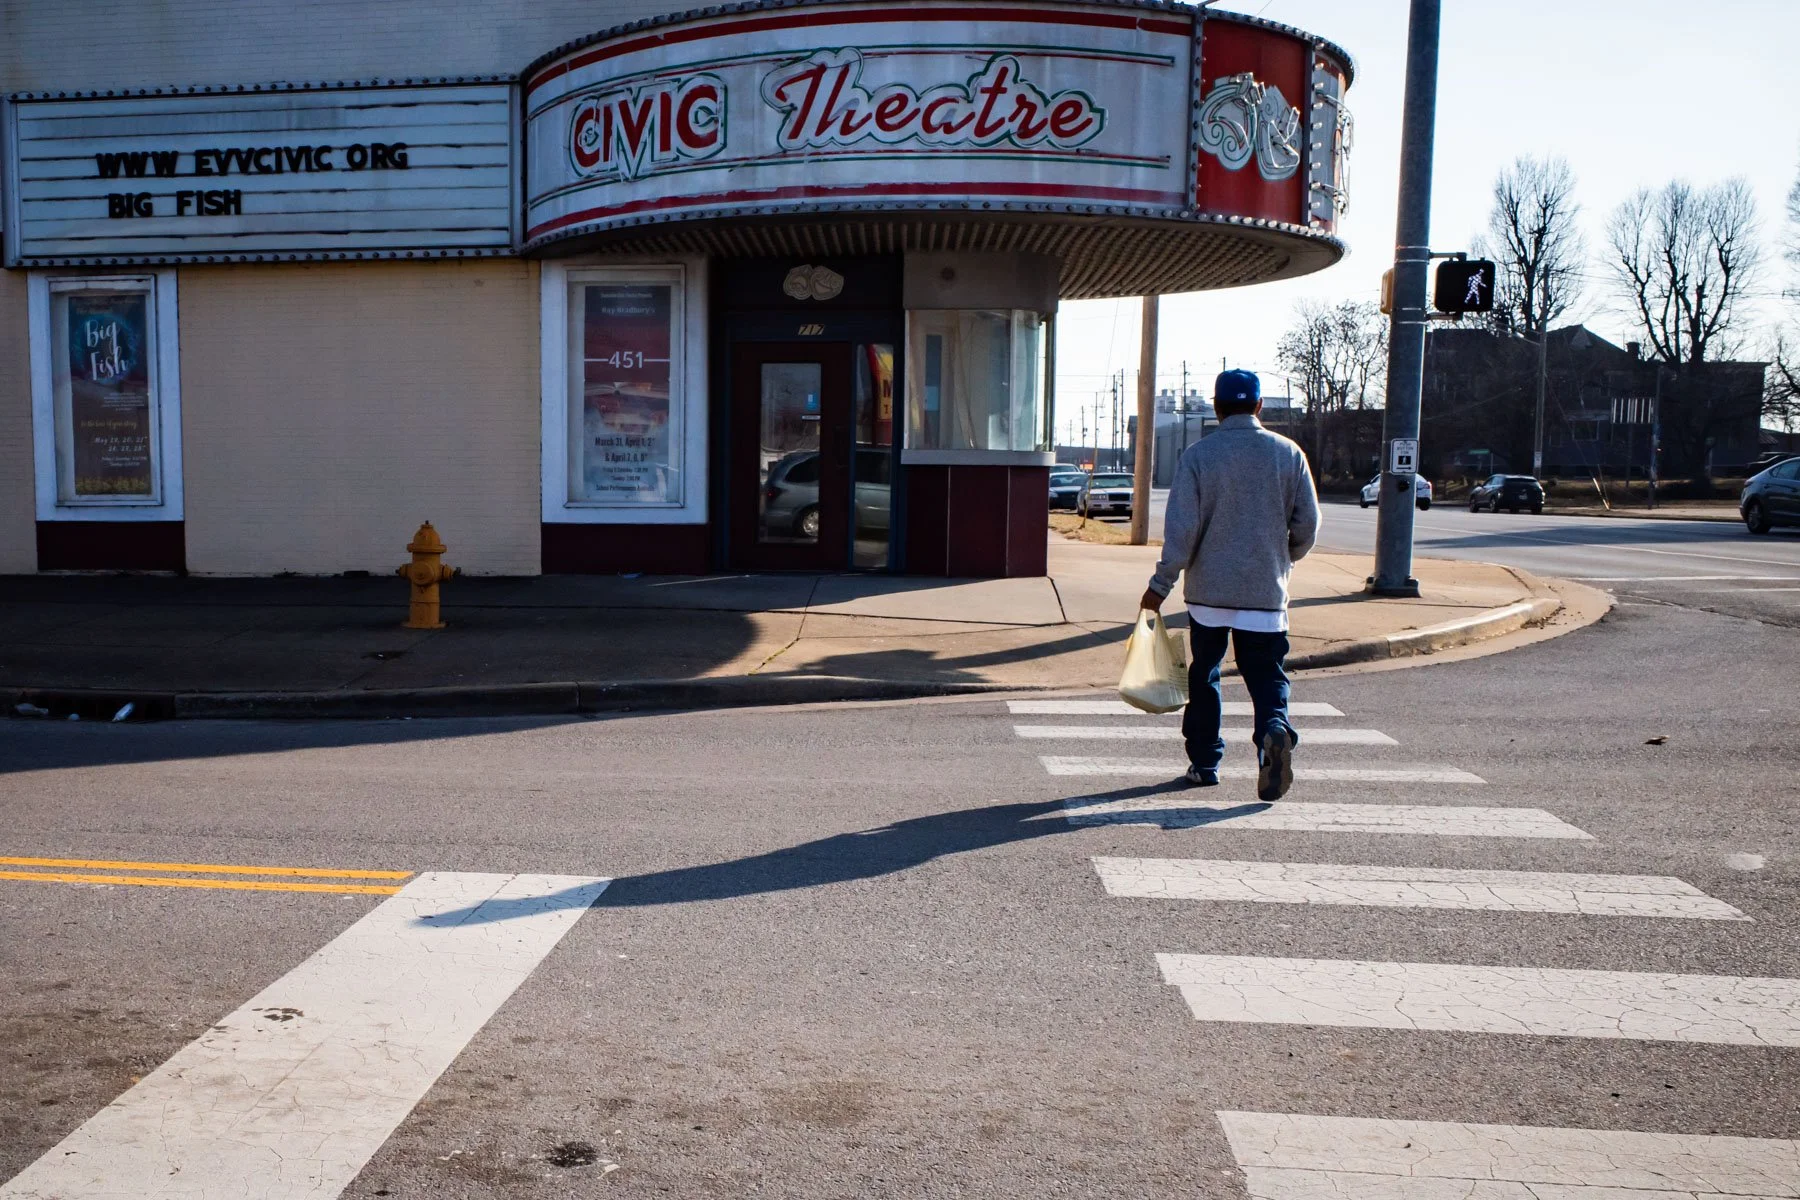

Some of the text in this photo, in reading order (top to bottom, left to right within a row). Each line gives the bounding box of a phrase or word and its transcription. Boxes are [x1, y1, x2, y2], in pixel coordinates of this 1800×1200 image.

[572, 59, 1096, 171] CIVIC Theatre
[96, 142, 408, 178] WWW EVVCIVIC ORG
[108, 189, 242, 218] BIG FISH
[84, 319, 119, 355] Big
[90, 346, 130, 381] Fish
[609, 351, 643, 369] 451
[595, 437, 614, 446] March
[625, 437, 640, 448] April
[611, 452, 626, 463] April
